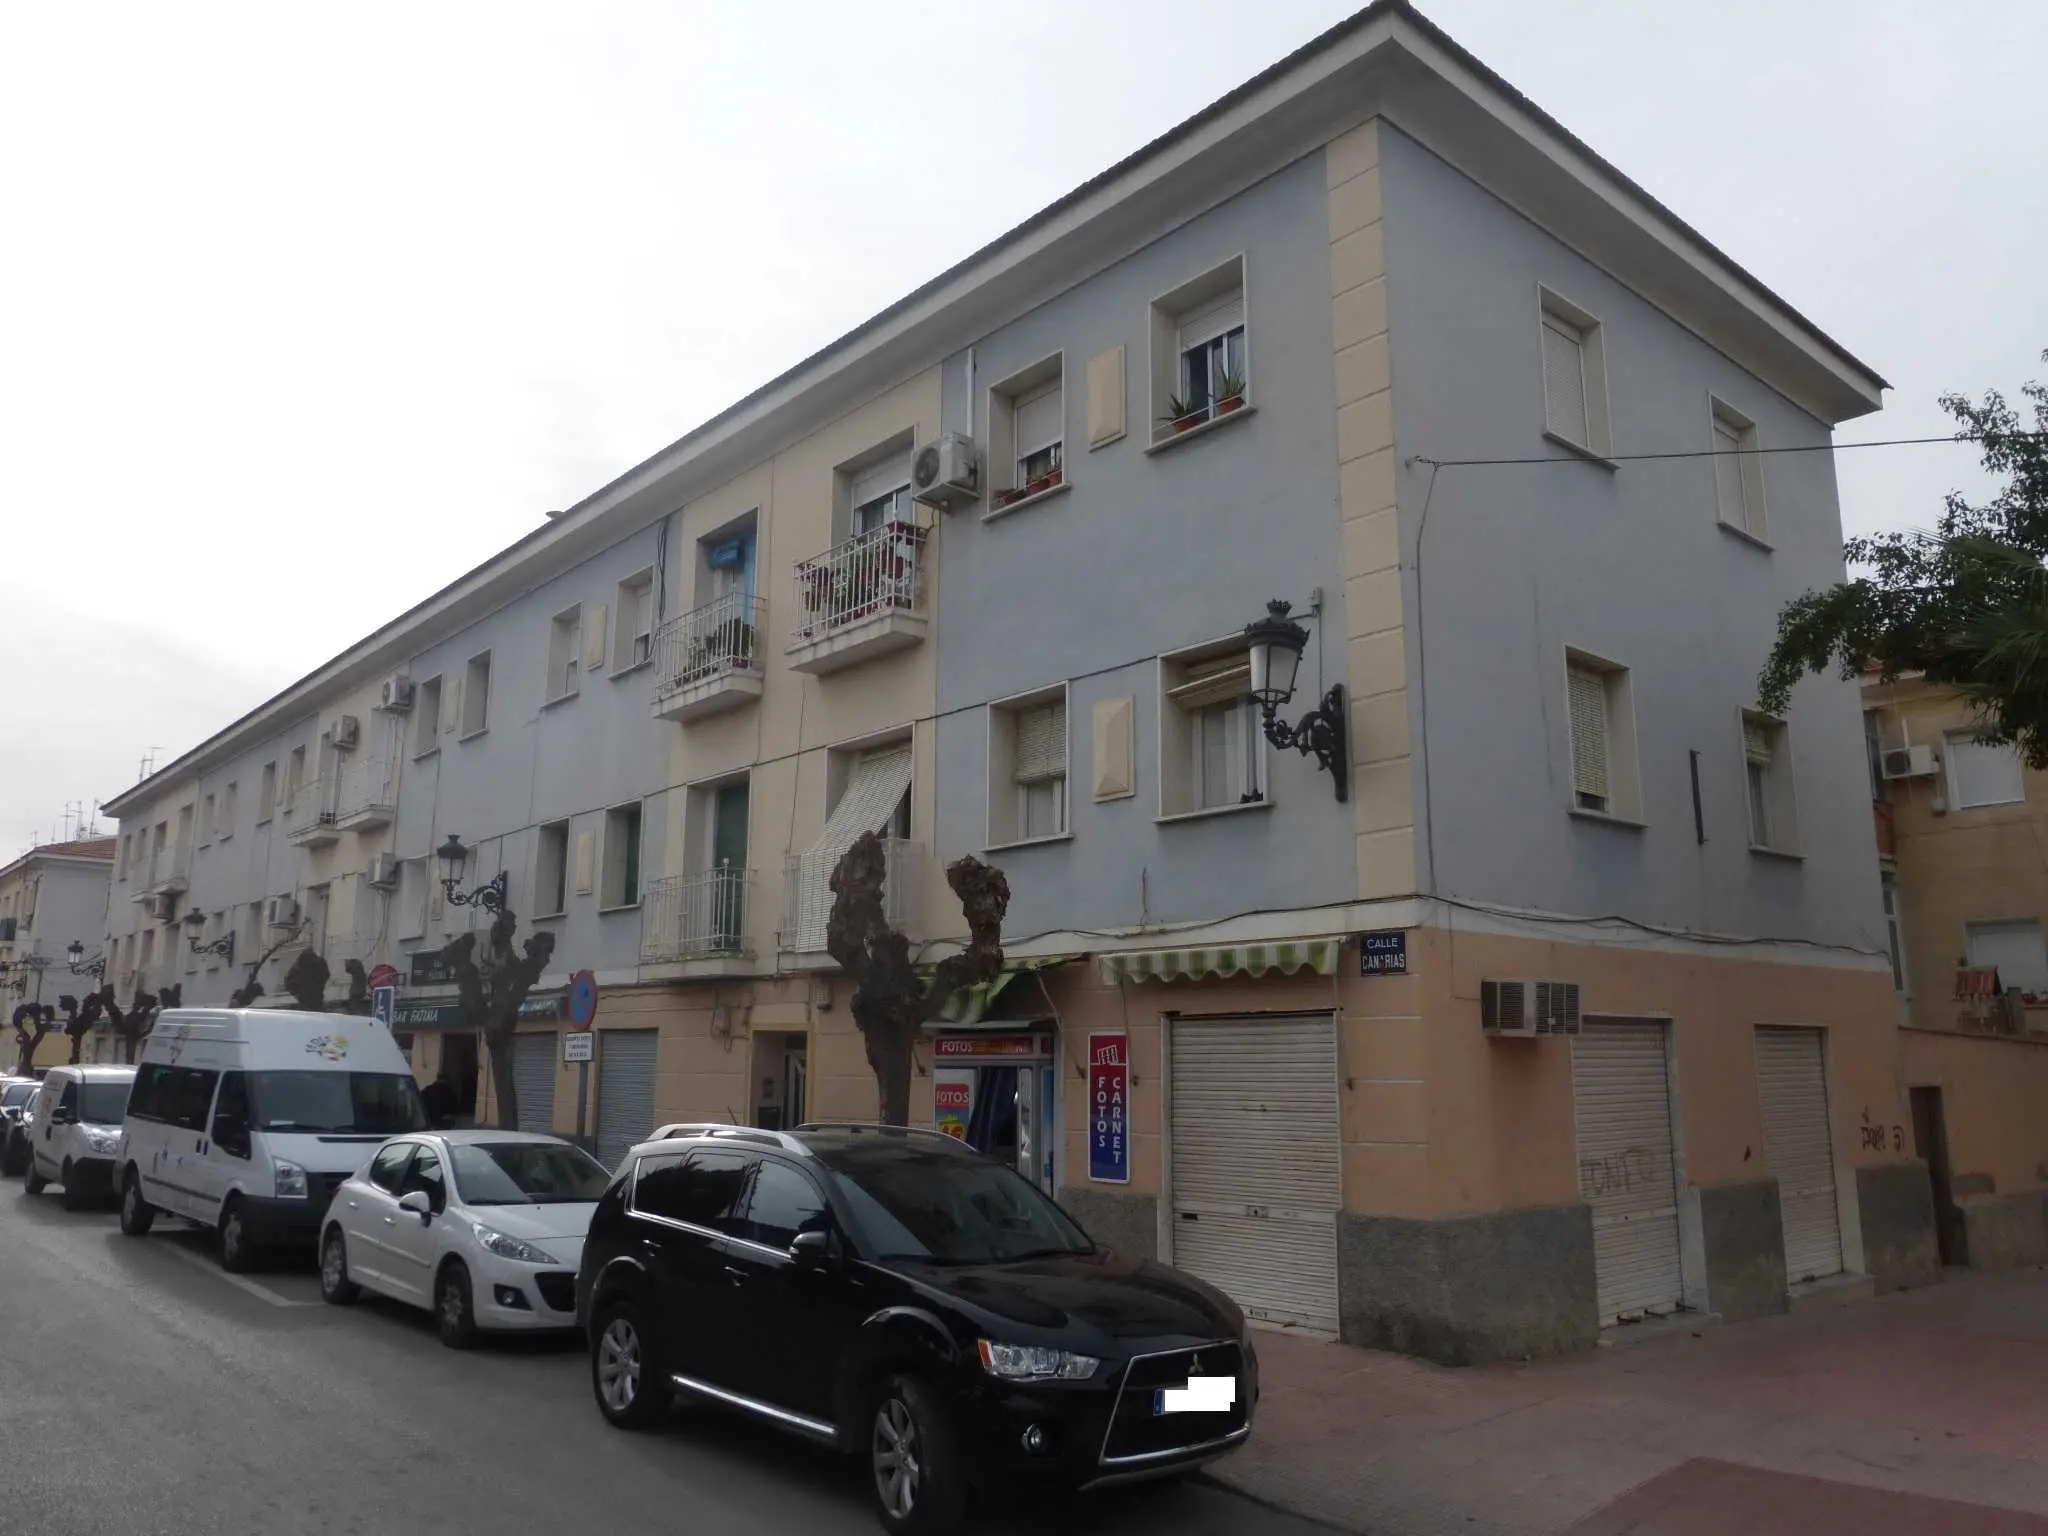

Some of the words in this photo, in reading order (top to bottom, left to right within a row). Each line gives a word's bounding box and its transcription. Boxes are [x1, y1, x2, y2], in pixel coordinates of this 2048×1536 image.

[1366, 937, 1400, 949] CALLE
[941, 1040, 973, 1053] FOTOS
[935, 1090, 970, 1105] FOTOS
[1097, 1077, 1107, 1148] FOTOS
[1112, 1077, 1122, 1165] CARNET
